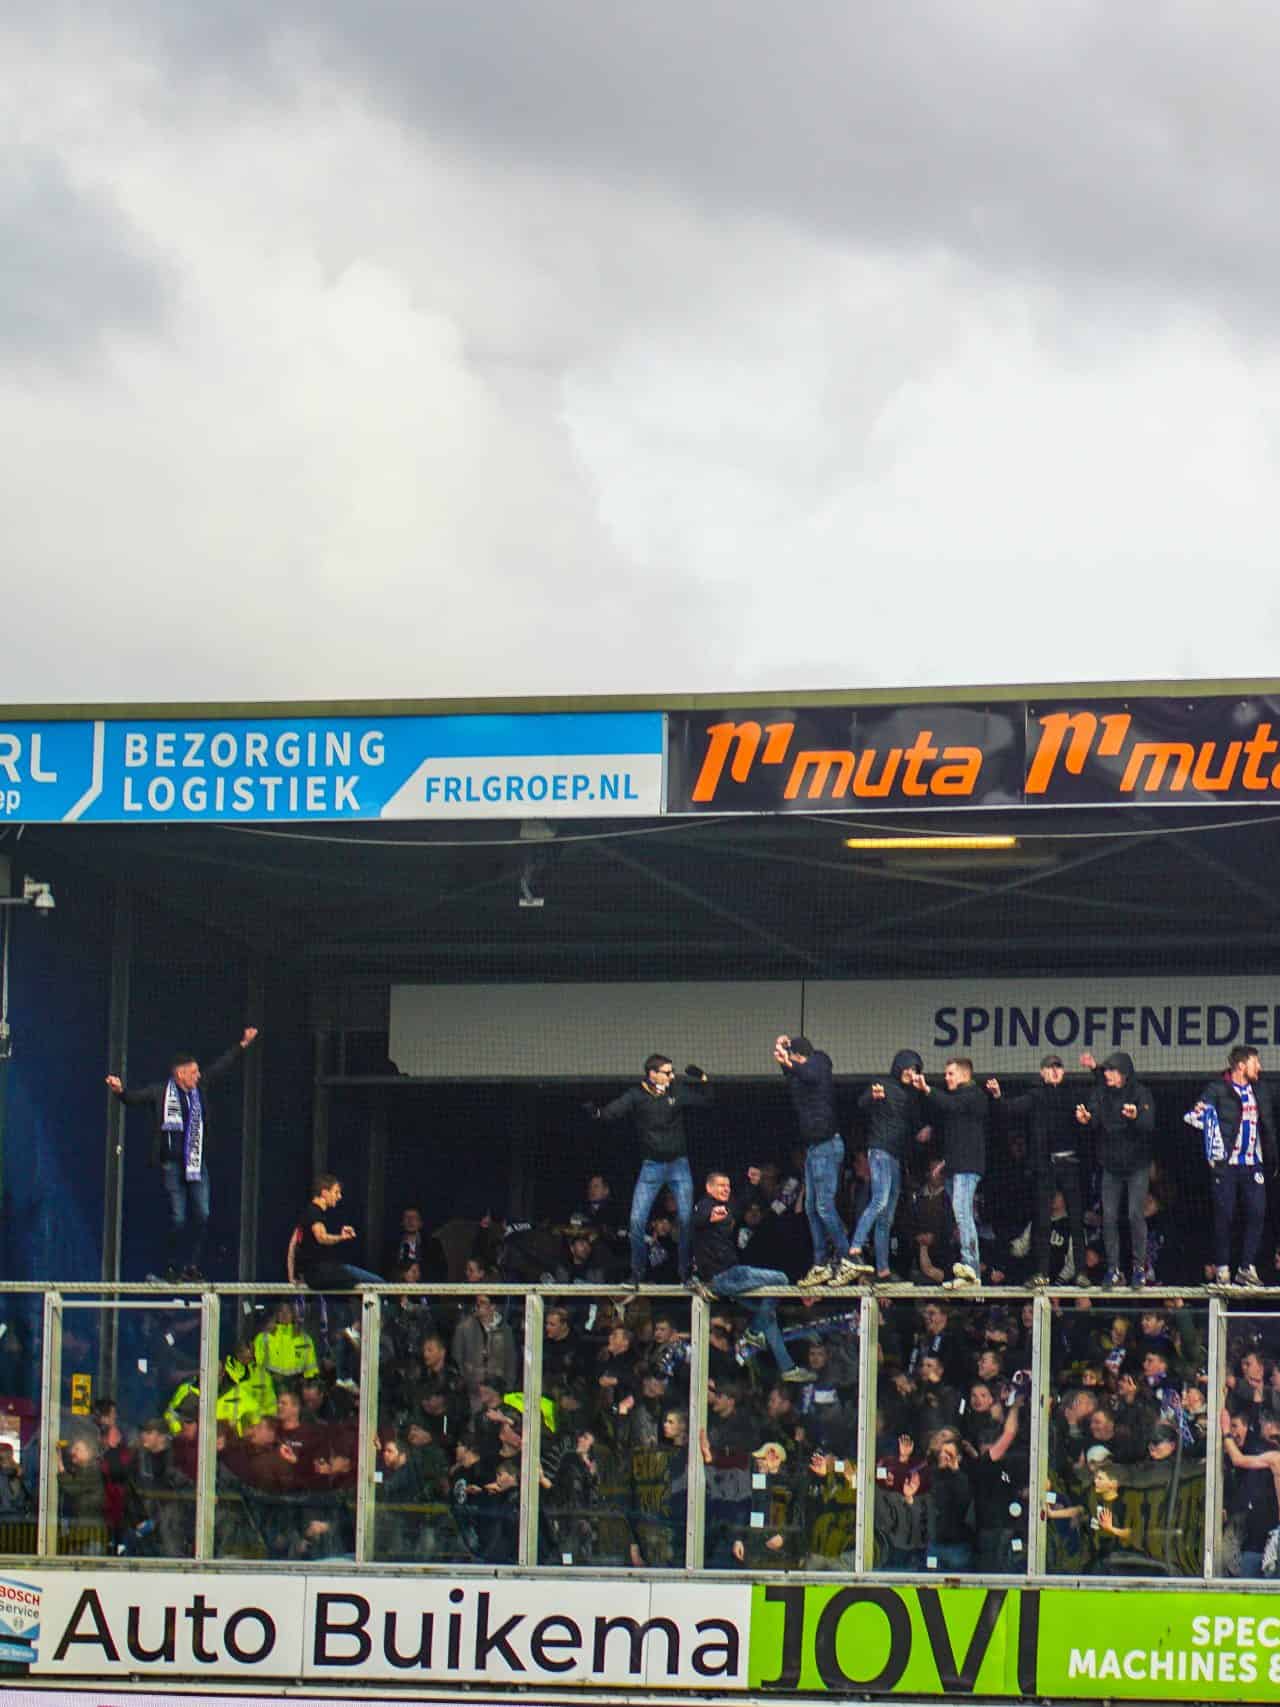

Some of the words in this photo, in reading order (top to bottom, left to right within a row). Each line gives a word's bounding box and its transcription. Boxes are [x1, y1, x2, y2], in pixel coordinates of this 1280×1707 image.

[125, 731, 385, 767] BEZORGING
[784, 731, 983, 799] muta
[123, 775, 361, 811] LOGISTIEK
[425, 773, 639, 803] FRLGROEP.NL
[52, 1588, 277, 1664] Auto
[313, 1588, 740, 1677] Buikema
[761, 1586, 1041, 1696] JOVI
[1068, 1648, 1258, 1682] MACHINES
